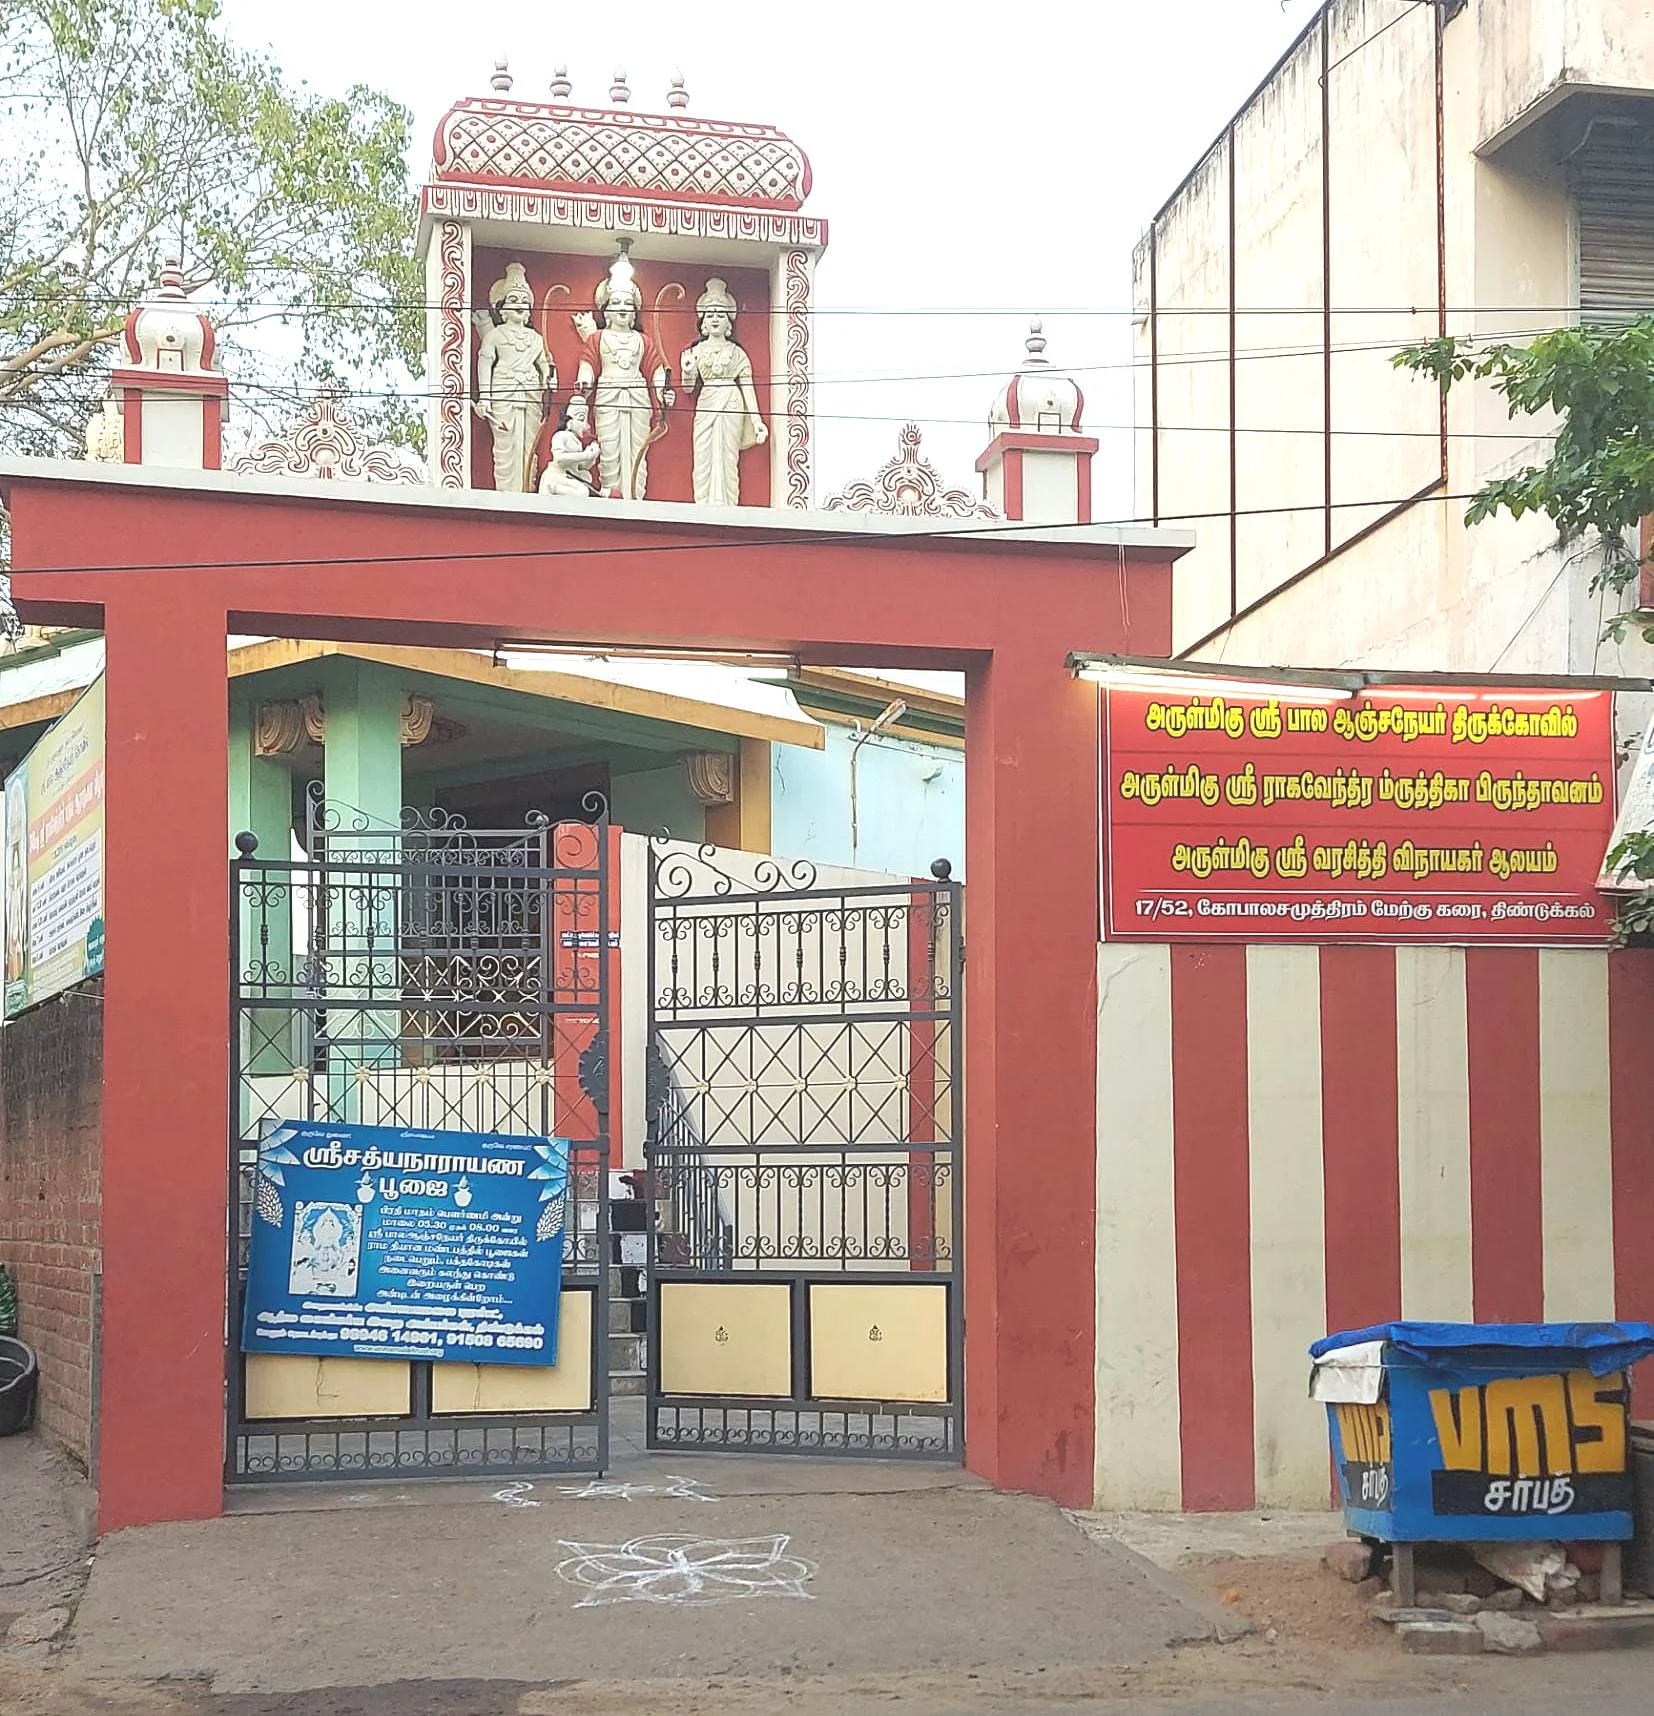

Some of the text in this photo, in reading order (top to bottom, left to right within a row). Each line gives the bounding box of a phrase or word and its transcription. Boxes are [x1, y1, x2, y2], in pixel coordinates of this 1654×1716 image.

[1146, 696, 1578, 743] அருள்மிகு ஸ்ரீ பால ஆஞ்சநேயர் திருக்கோவில்
[1120, 762, 1603, 811] அருள்மிகு ஸ்ரீ ராகவேந்த்ர ம்ருத்திகா பிருந்தாவனம்
[1171, 834, 1558, 880] அருள்மிகு ஸ்ரீ வரசித்தி விநாயகர் ஆலயம்
[1136, 897, 1595, 921] 17/52, கோபாலசமுத்திரம் மேற்கு கரை, திண்டுக்கல்
[379, 1176, 448, 1200] பூஜை
[1484, 1471, 1574, 1514] சர்பத்
